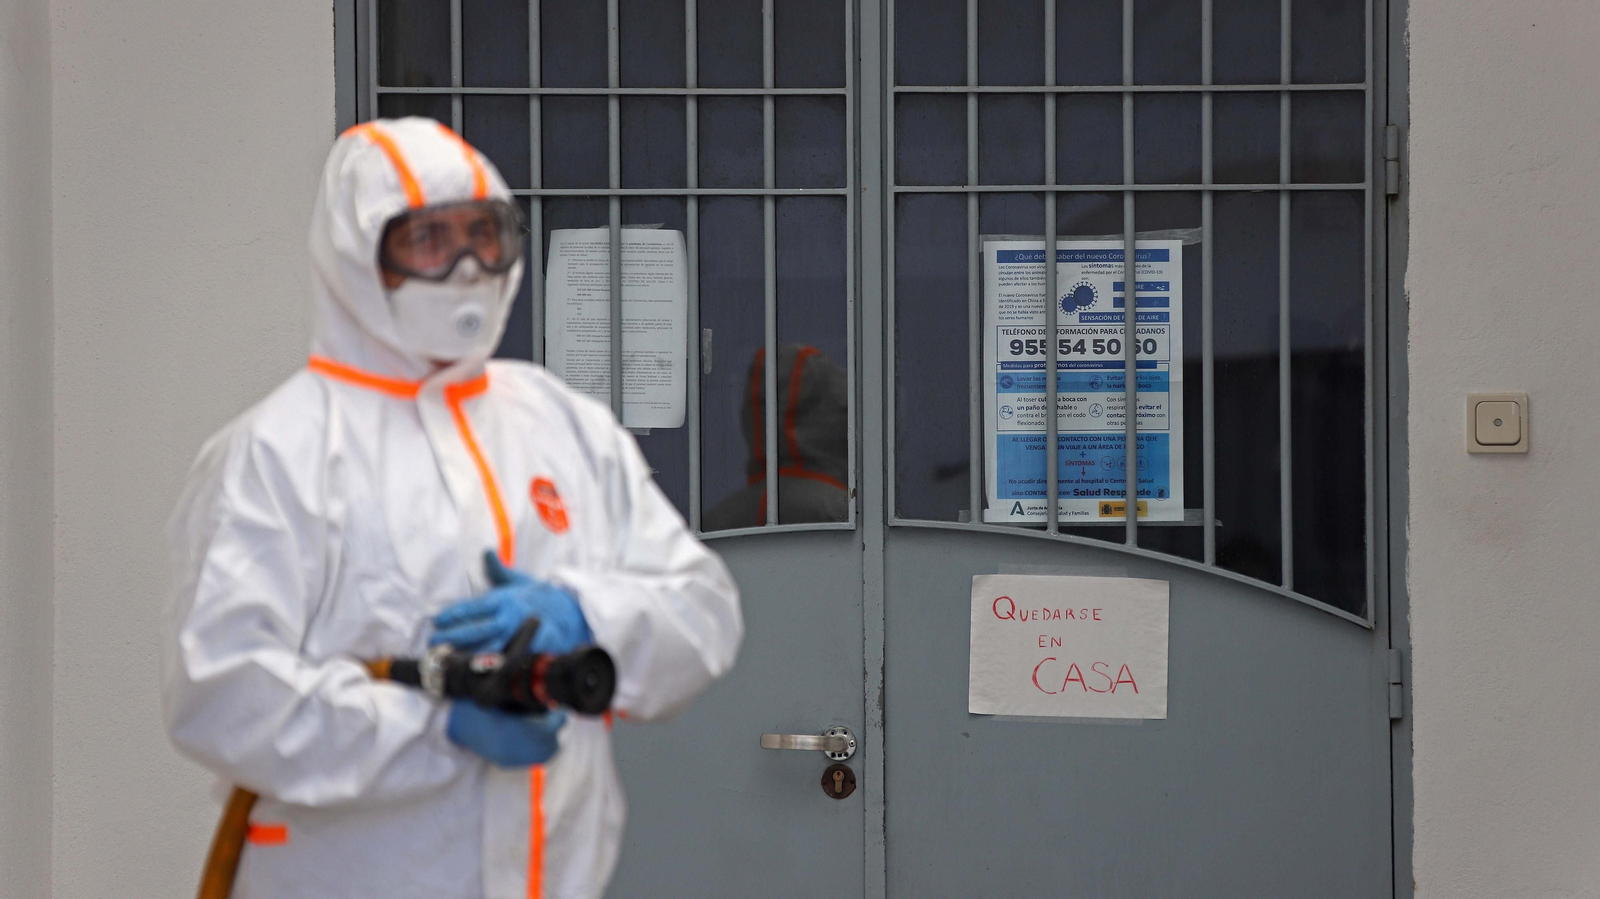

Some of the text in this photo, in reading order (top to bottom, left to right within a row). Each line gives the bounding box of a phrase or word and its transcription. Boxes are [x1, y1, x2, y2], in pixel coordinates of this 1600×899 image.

[1010, 339, 1049, 355] 955
[1058, 339, 1086, 355] 54
[1093, 338, 1121, 355] 50
[1103, 488, 1151, 497] Respde
[1038, 635, 1062, 648] EN
[1032, 657, 1139, 694] CASA
